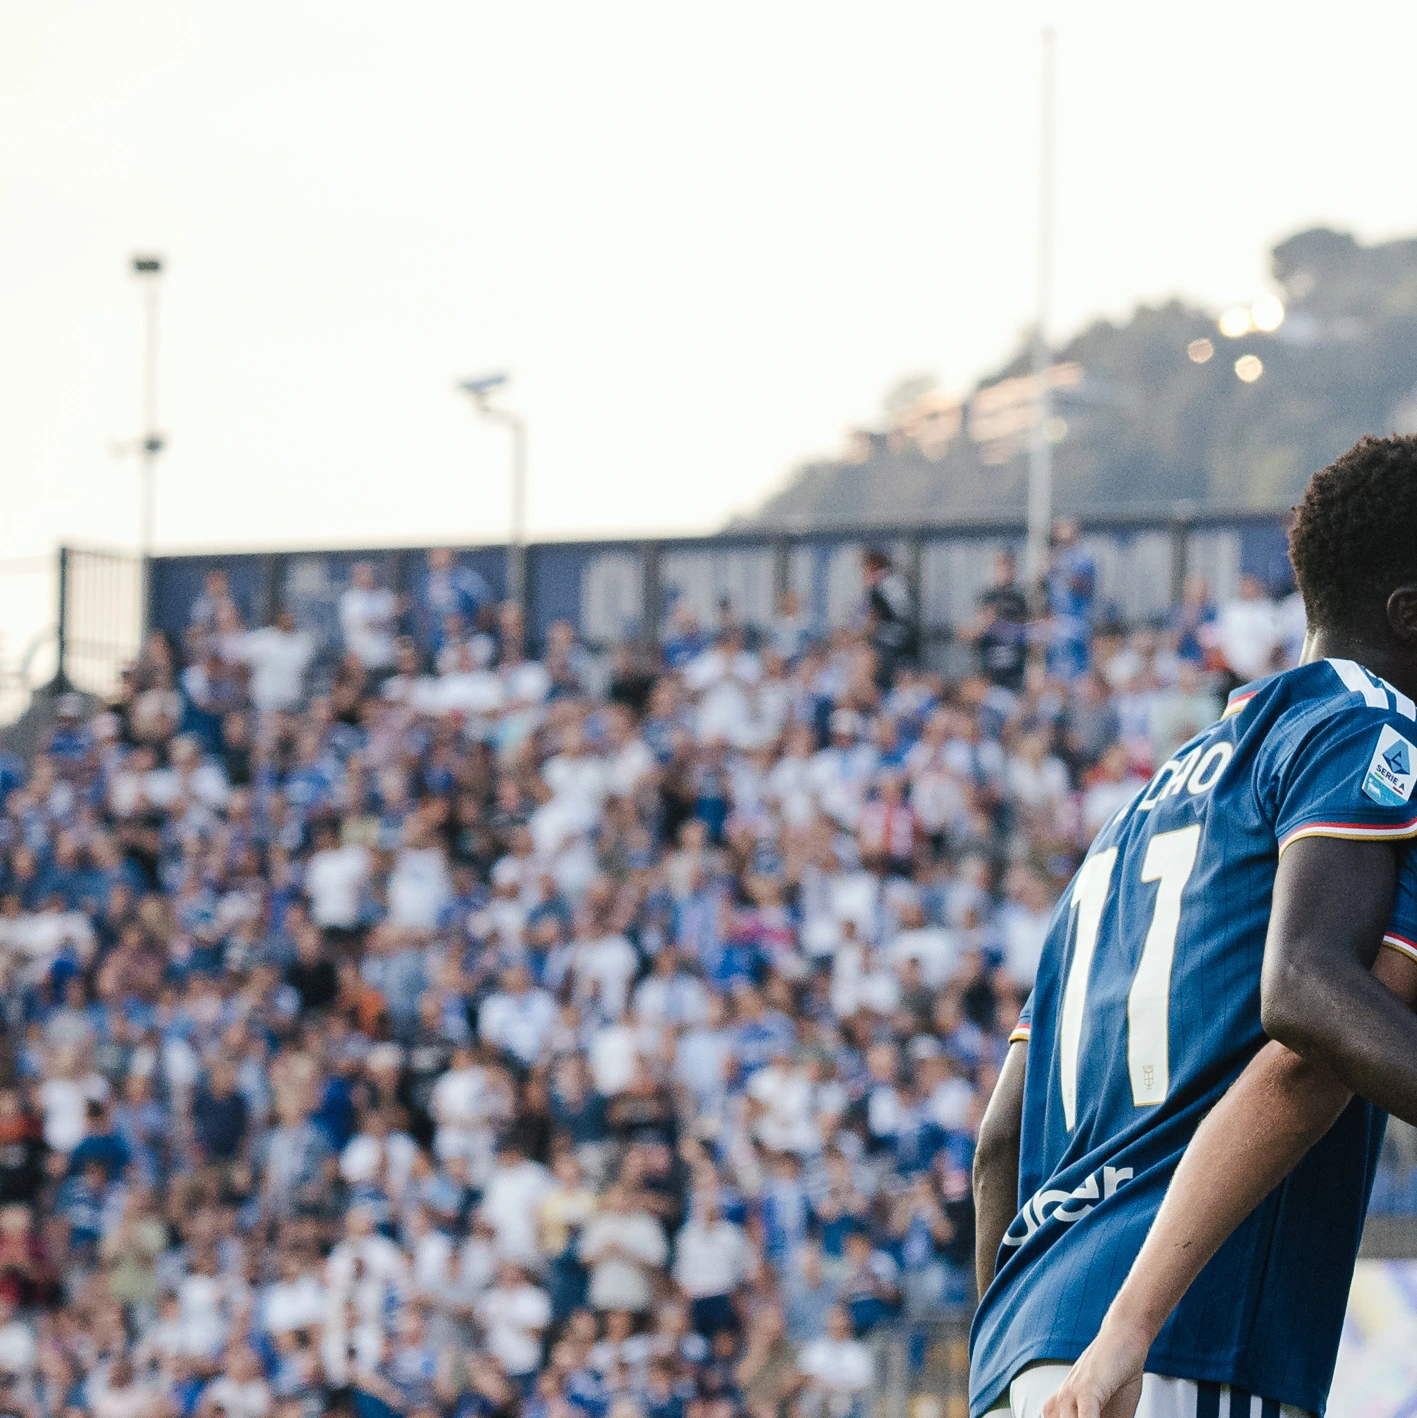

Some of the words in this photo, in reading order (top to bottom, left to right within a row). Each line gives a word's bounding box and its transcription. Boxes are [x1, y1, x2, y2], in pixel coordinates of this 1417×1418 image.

[1376, 764, 1399, 787] SERIE
[1399, 783, 1405, 791] A
[1060, 824, 1201, 1133] 11
